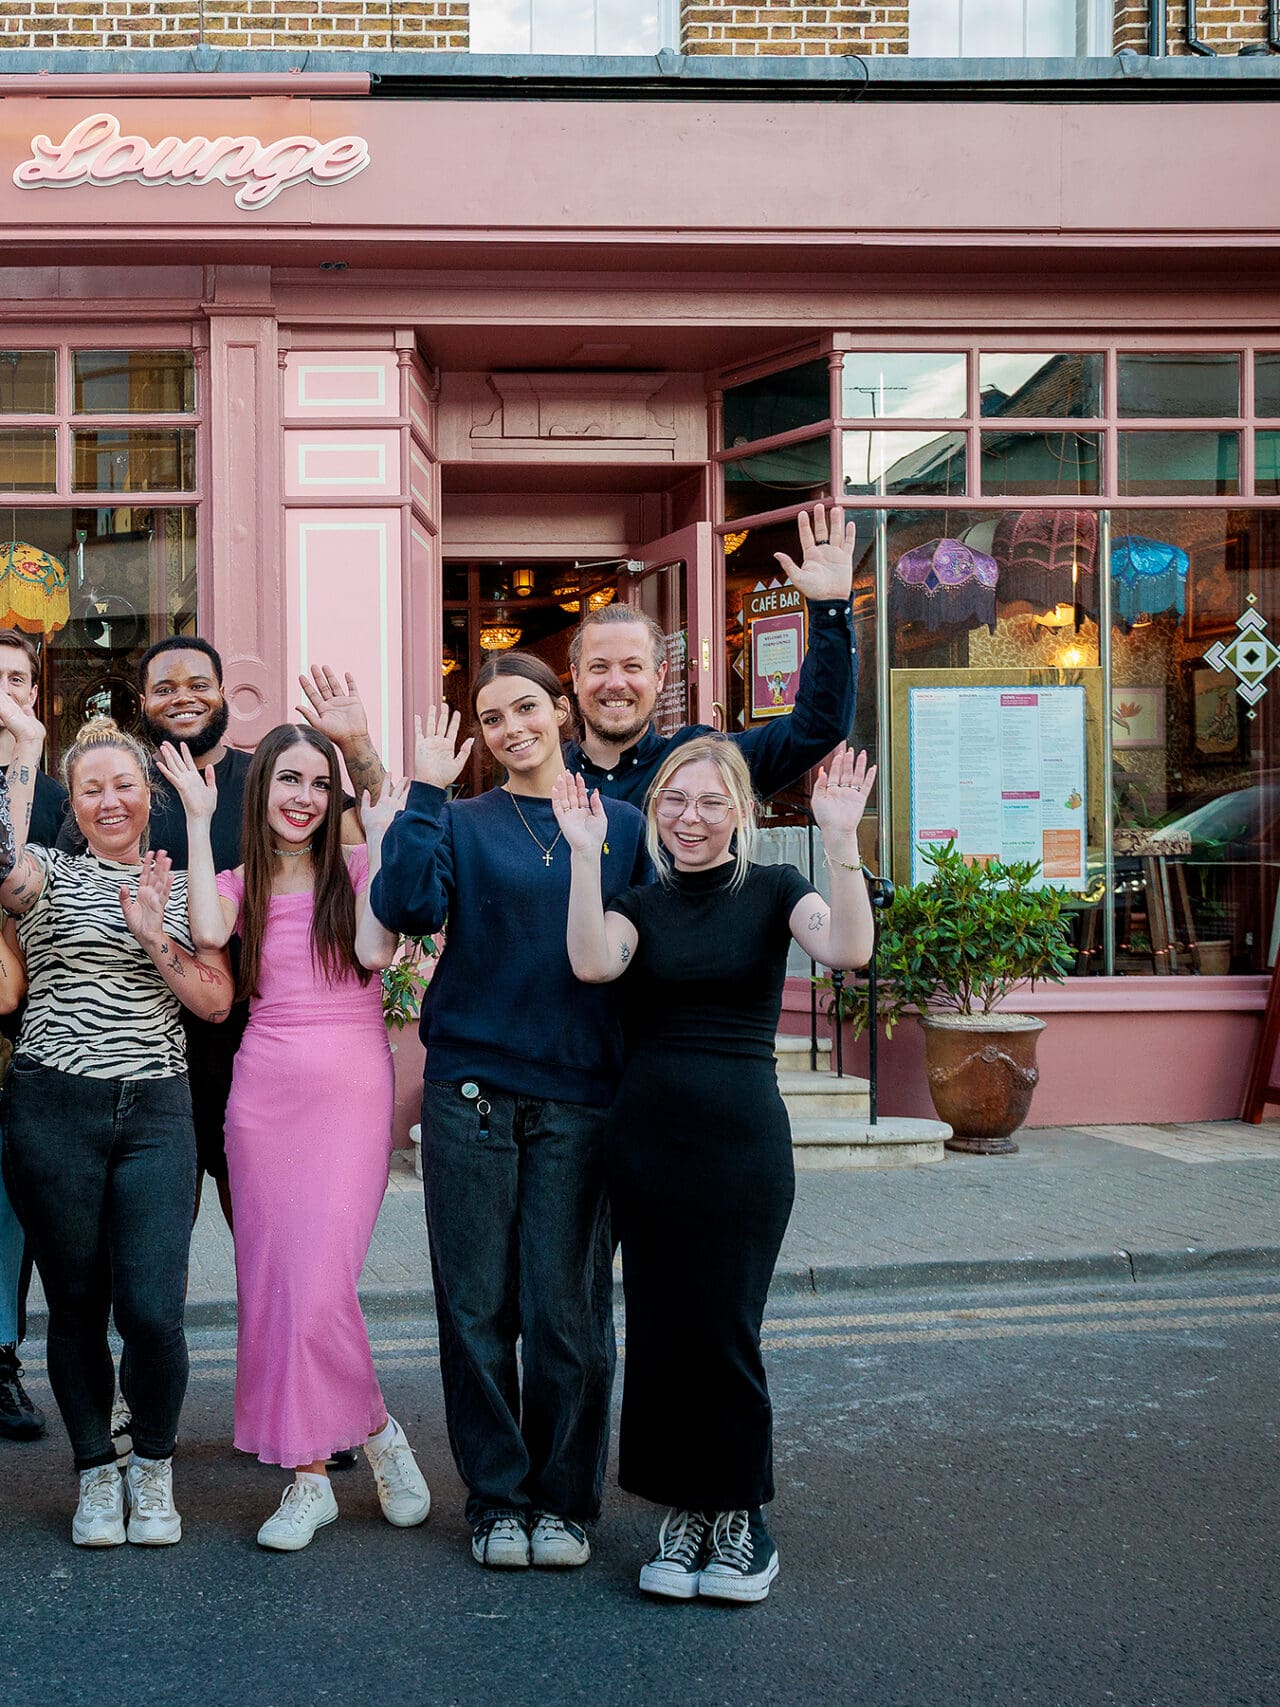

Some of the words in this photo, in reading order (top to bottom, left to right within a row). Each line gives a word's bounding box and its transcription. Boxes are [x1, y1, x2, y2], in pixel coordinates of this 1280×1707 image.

[19, 114, 364, 207] Lounge
[751, 592, 777, 613] CAFÉ
[780, 591, 801, 609] BAR
